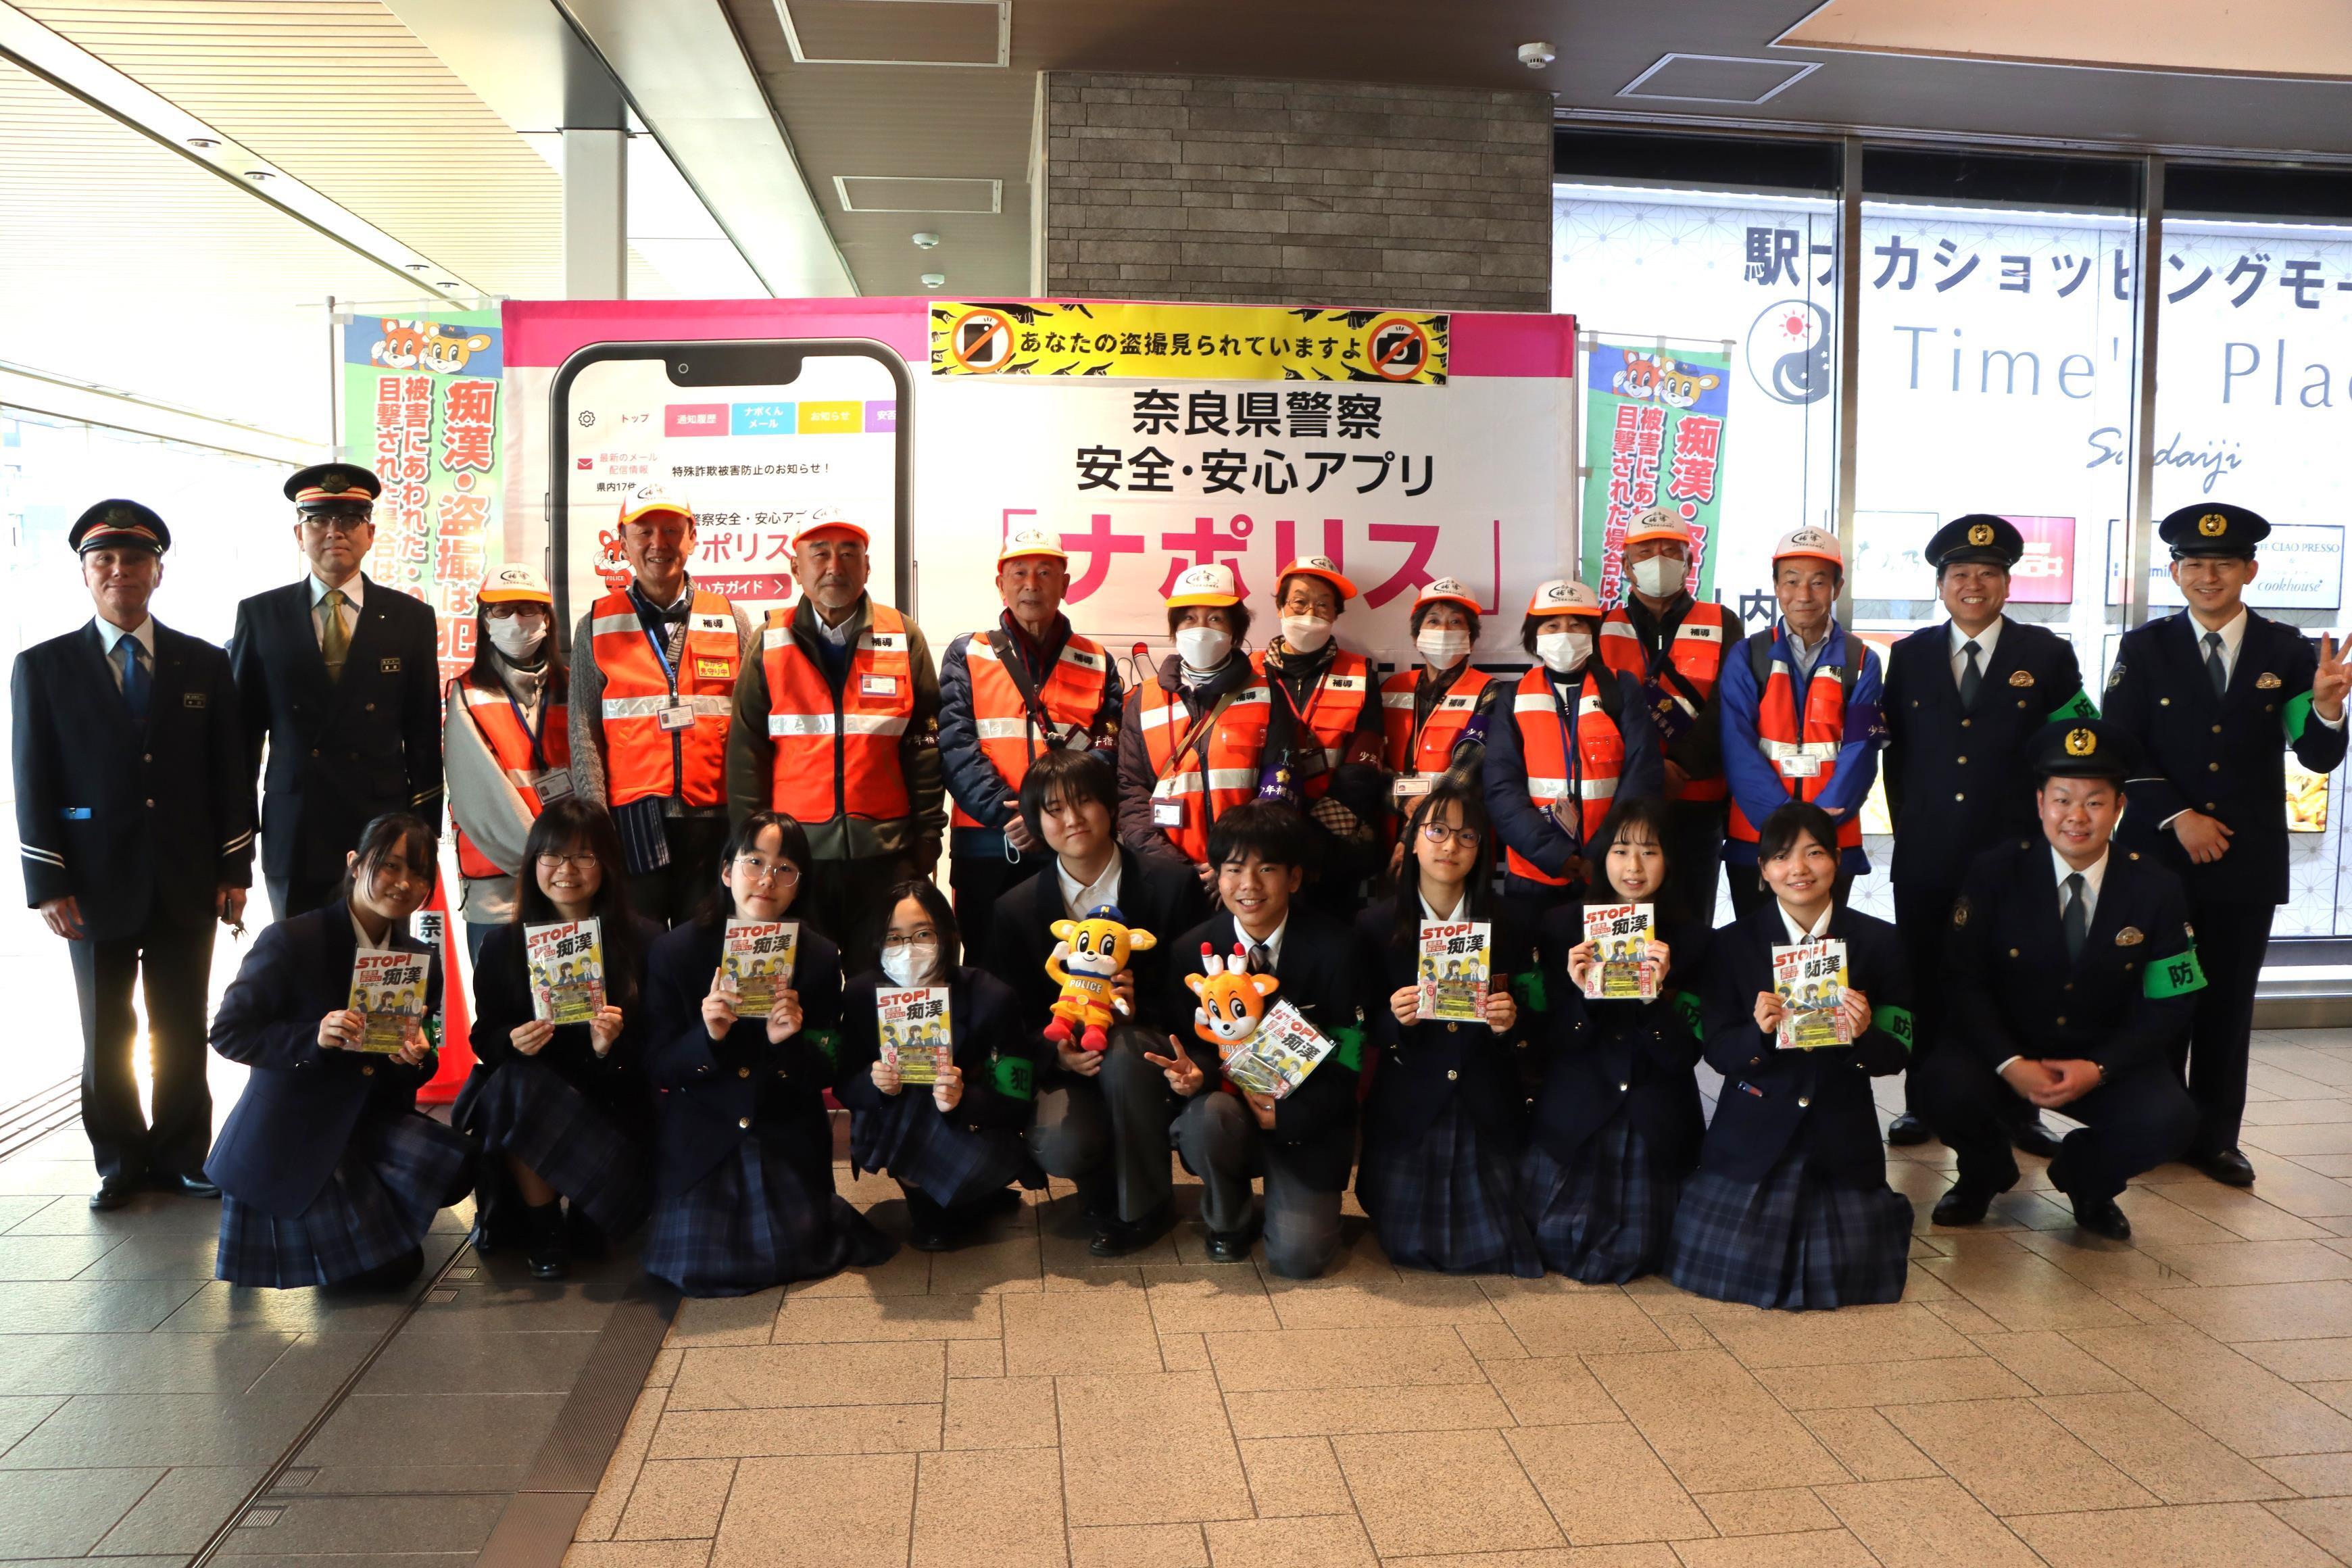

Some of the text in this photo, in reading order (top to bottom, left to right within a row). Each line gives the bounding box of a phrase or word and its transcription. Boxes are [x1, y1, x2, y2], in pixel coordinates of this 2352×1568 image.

[1020, 330, 1363, 361] あなたの盗撮見られていますよ
[1894, 326, 2352, 408] Time' Pla
[620, 414, 650, 423] トップ
[677, 414, 717, 424] 通知履歴
[744, 406, 784, 417] ナポくん
[811, 411, 850, 421] お知らせ
[1133, 388, 1382, 439] 奈良県警察
[750, 418, 778, 428] メール
[599, 452, 658, 463] 最新のメール
[609, 464, 649, 474] 配信情報
[672, 463, 831, 477] 特殊詐欺被害防止のお知らせ！
[1076, 444, 1434, 495] 安全・安心アプリ
[1600, 406, 1638, 597] 目撃された場合は
[694, 532, 793, 563] ポリス
[2302, 543, 2340, 553] PRESSO
[697, 580, 763, 595] い方ガイド
[2257, 578, 2320, 592] cookhouse
[703, 619, 723, 628] 補導
[1690, 628, 1710, 637] 補導
[871, 637, 892, 647] 補導
[700, 668, 728, 676] 見守り中
[1332, 679, 1352, 687] 補導
[1584, 903, 1636, 924] STOP!
[725, 923, 782, 939] STOP!
[1420, 922, 1473, 940] STOP!
[1612, 914, 1648, 936] 痴漢
[527, 920, 579, 948] STOP!
[556, 932, 592, 958] 痴漢
[753, 934, 792, 954] 痴漢
[1447, 934, 1485, 954] 痴漢
[356, 953, 412, 969] STOP!
[382, 966, 424, 986] 痴漢
[2168, 961, 2194, 989] 防
[1069, 979, 1103, 994] POLICE
[876, 988, 930, 1008] STOP!
[906, 999, 944, 1021] 痴漢
[1281, 1033, 1321, 1062] 痴漢
